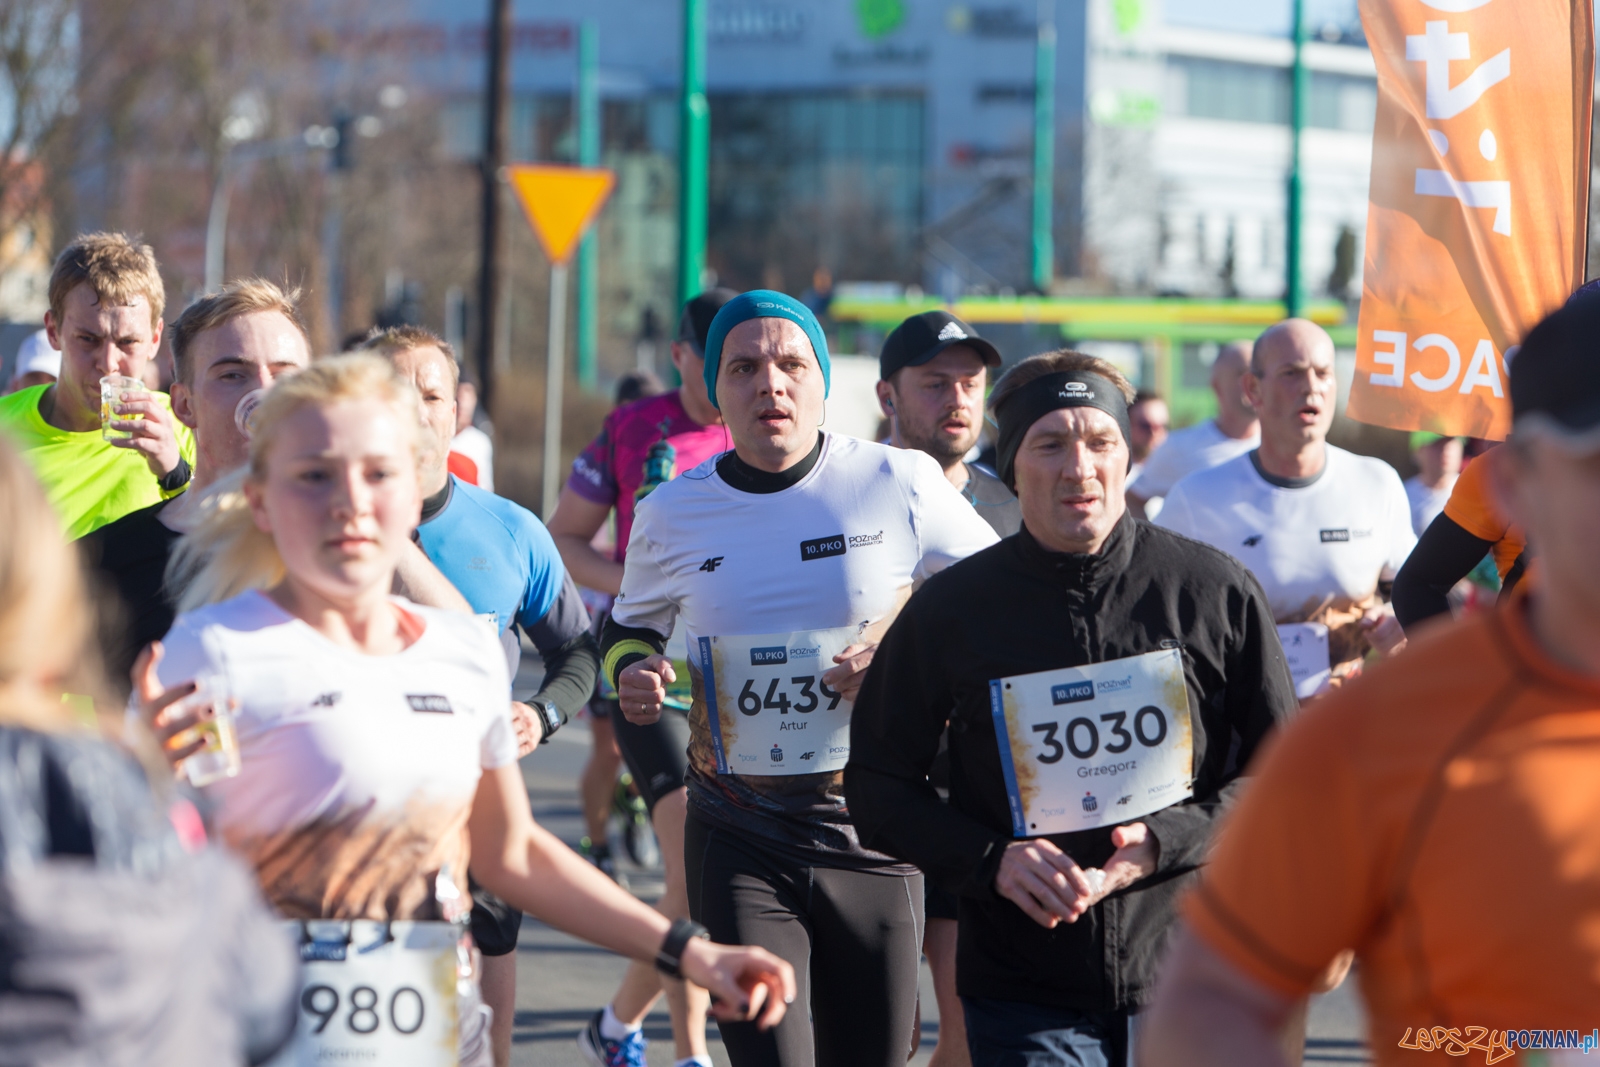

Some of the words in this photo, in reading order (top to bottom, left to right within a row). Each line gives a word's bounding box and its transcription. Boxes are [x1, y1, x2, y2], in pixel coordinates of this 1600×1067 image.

[805, 545, 819, 555] 10.
[820, 540, 842, 553] PKO
[754, 652, 765, 660] 10.
[766, 651, 784, 660] PKO
[737, 675, 842, 716] 6439
[1070, 686, 1091, 698] PKO
[779, 720, 808, 731] Artur
[1032, 705, 1167, 764] 3030
[1077, 760, 1137, 778] Grzegorz
